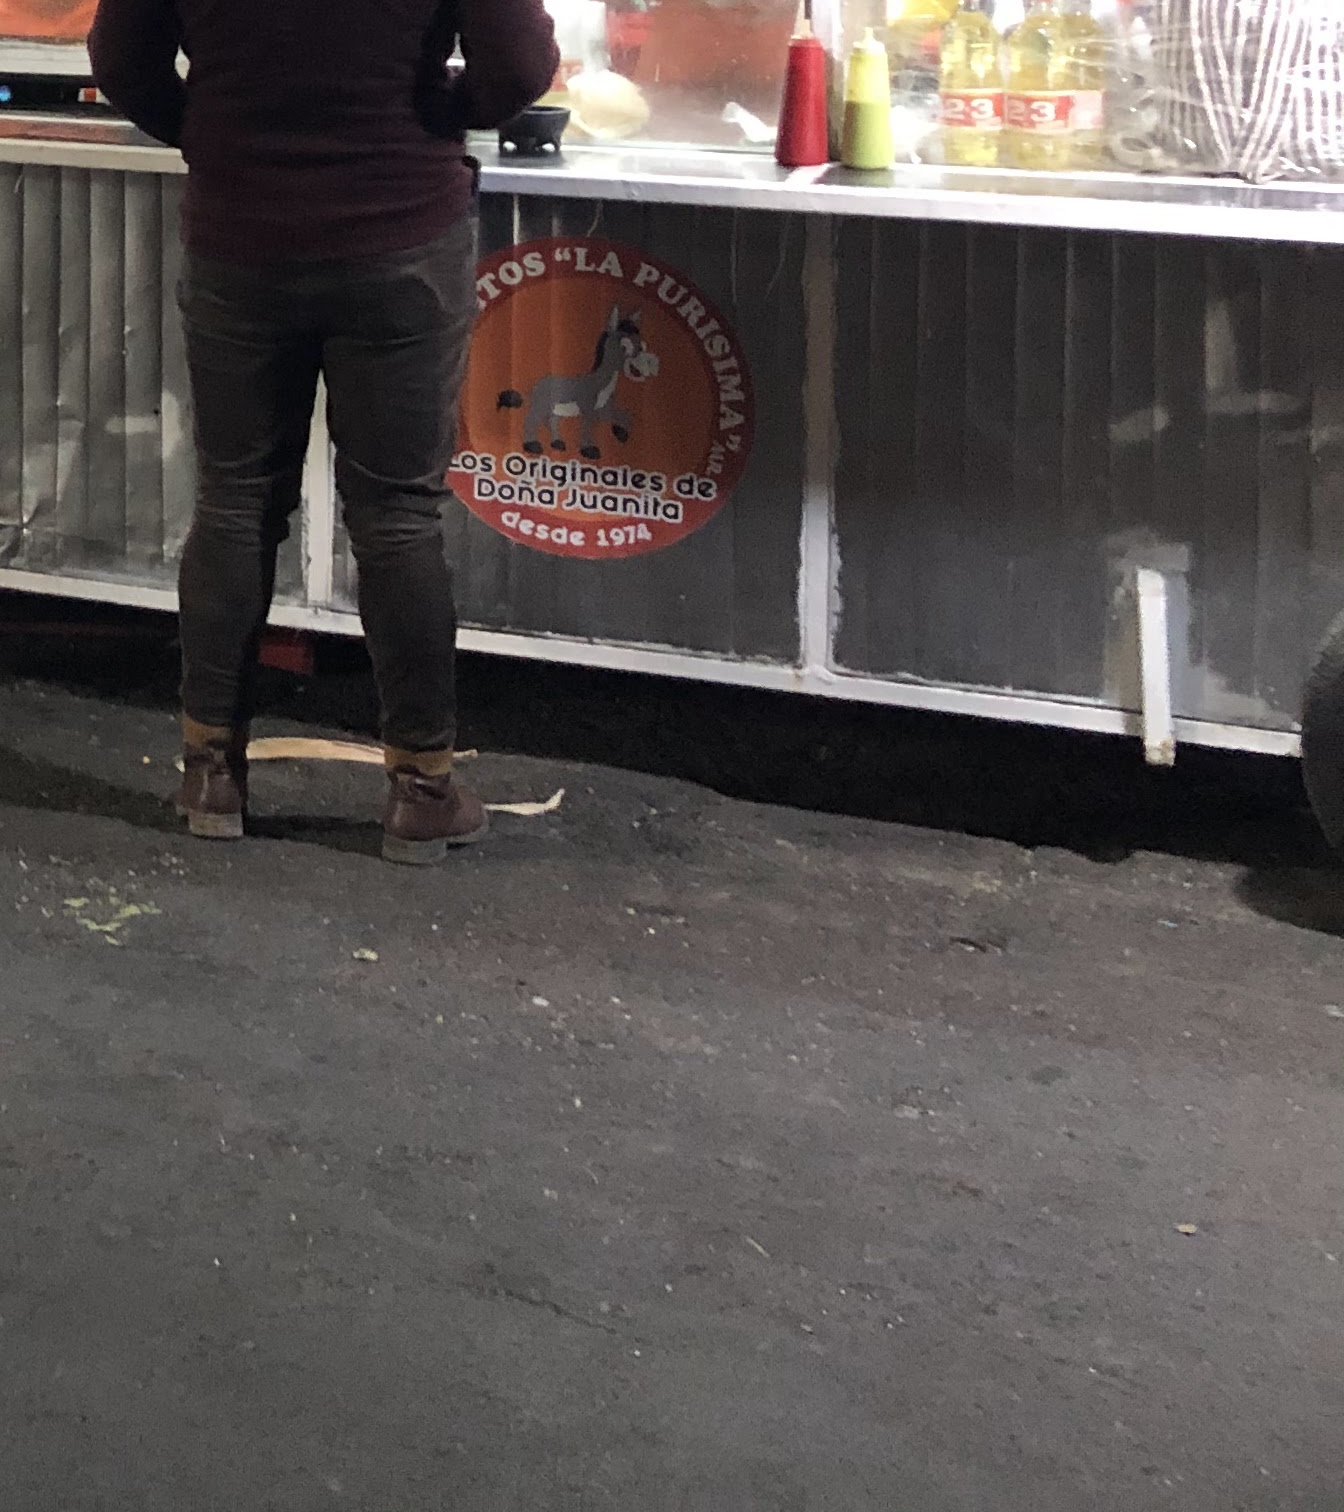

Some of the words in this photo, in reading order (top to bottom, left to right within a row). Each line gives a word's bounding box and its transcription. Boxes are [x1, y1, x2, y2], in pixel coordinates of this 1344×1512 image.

[505, 454, 665, 494] Originales
[674, 472, 716, 499] de
[477, 477, 555, 507] Doña
[566, 490, 682, 521] Juanita
[501, 510, 585, 547] desde
[596, 522, 653, 548] 1974
